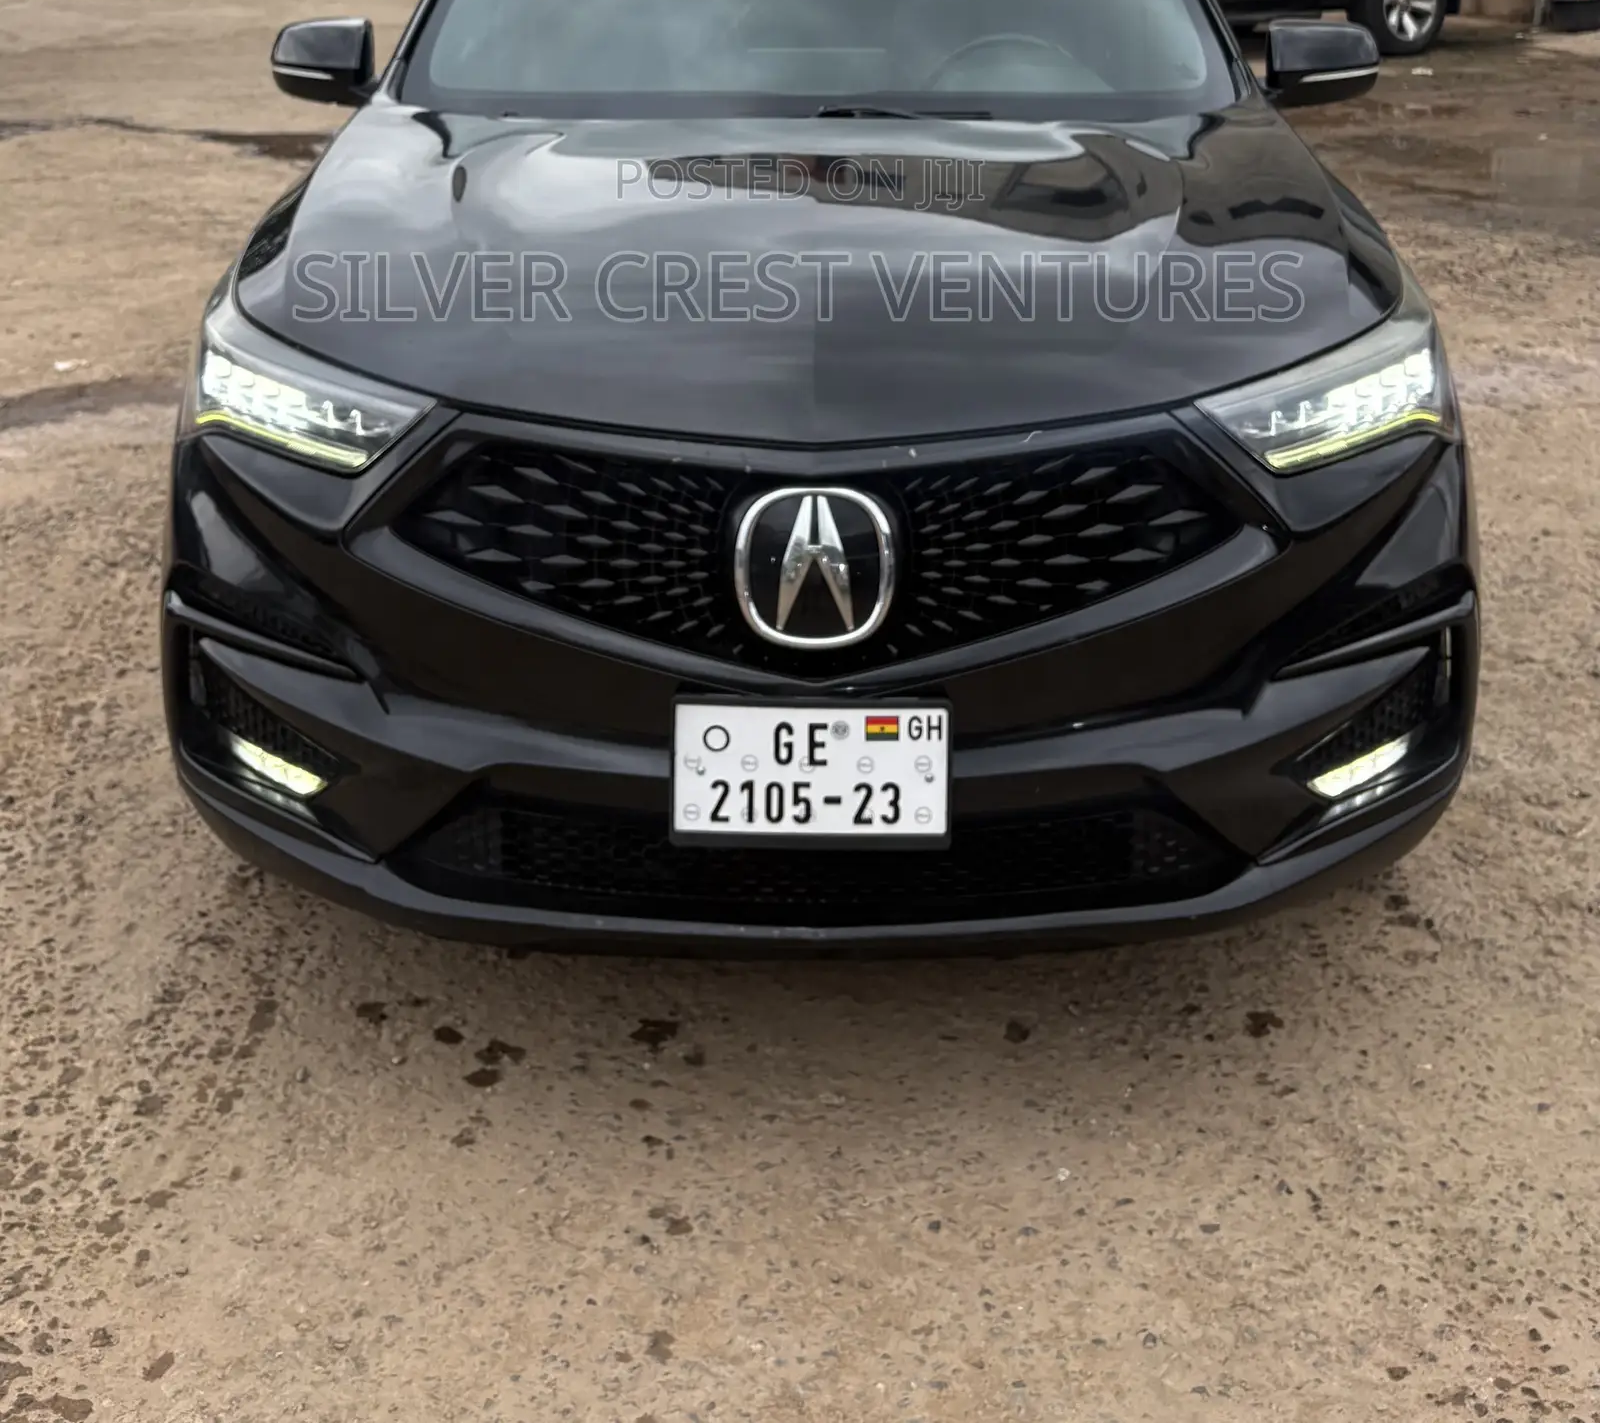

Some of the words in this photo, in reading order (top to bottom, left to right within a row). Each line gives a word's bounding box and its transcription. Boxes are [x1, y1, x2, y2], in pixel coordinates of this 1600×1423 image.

[773, 721, 829, 767] GE
[907, 715, 943, 741] GH
[709, 779, 901, 826] 2105-23
